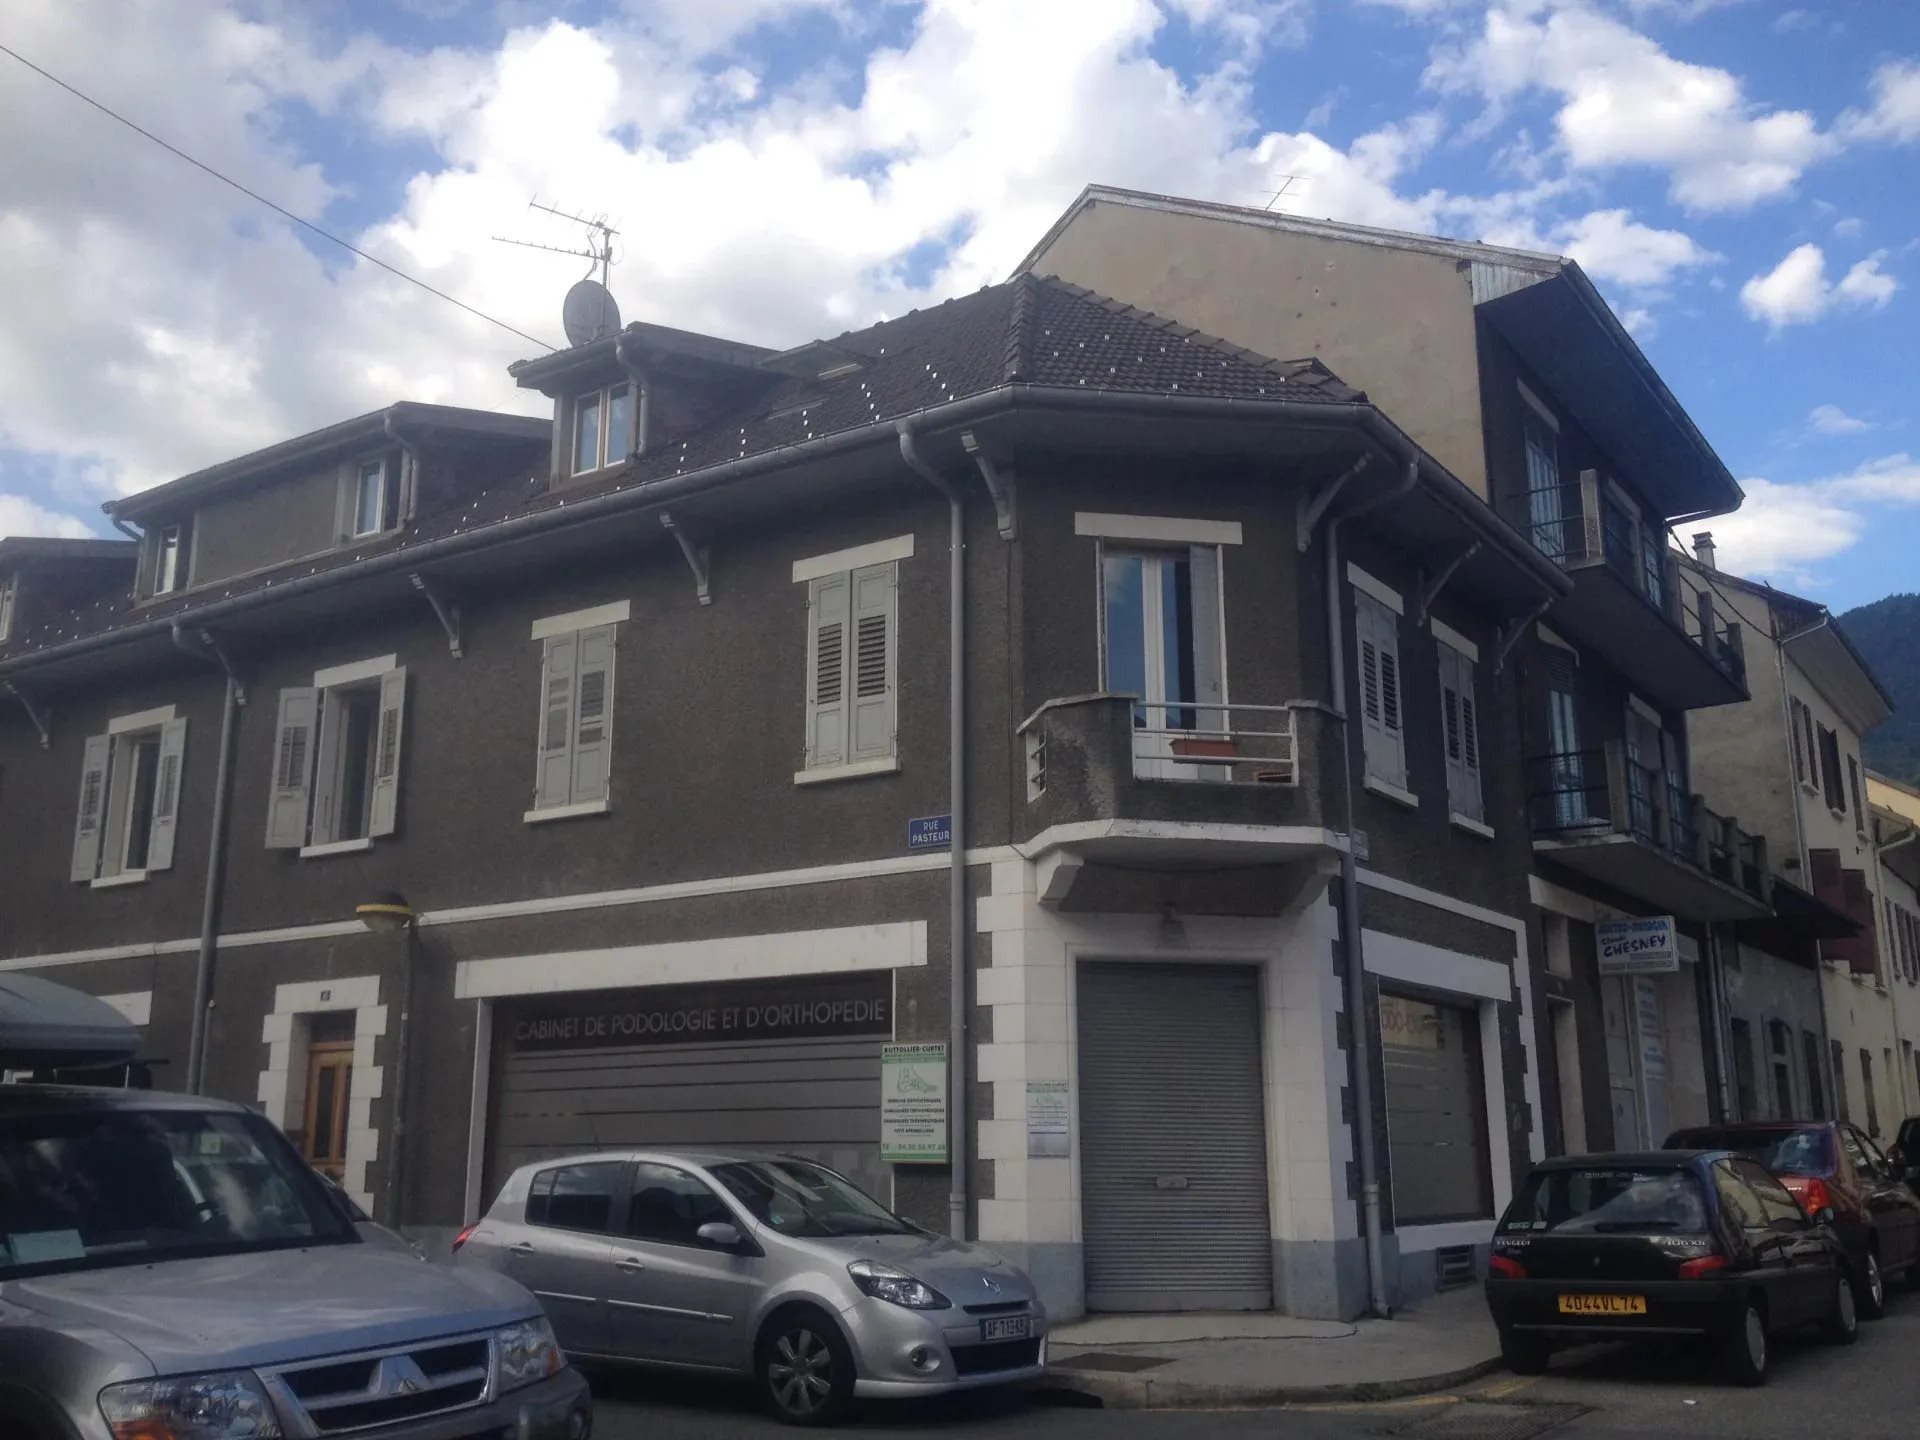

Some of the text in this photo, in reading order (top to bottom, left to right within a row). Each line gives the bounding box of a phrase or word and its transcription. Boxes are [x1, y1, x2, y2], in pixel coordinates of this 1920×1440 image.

[923, 820, 939, 831] RUE
[912, 831, 950, 844] PASTEUR
[1603, 933, 1666, 958] CHESNEY
[516, 1017, 579, 1040] CABINET
[585, 1015, 606, 1035] DE
[611, 1007, 716, 1034] PODOLOGIE
[722, 1007, 740, 1029] ET
